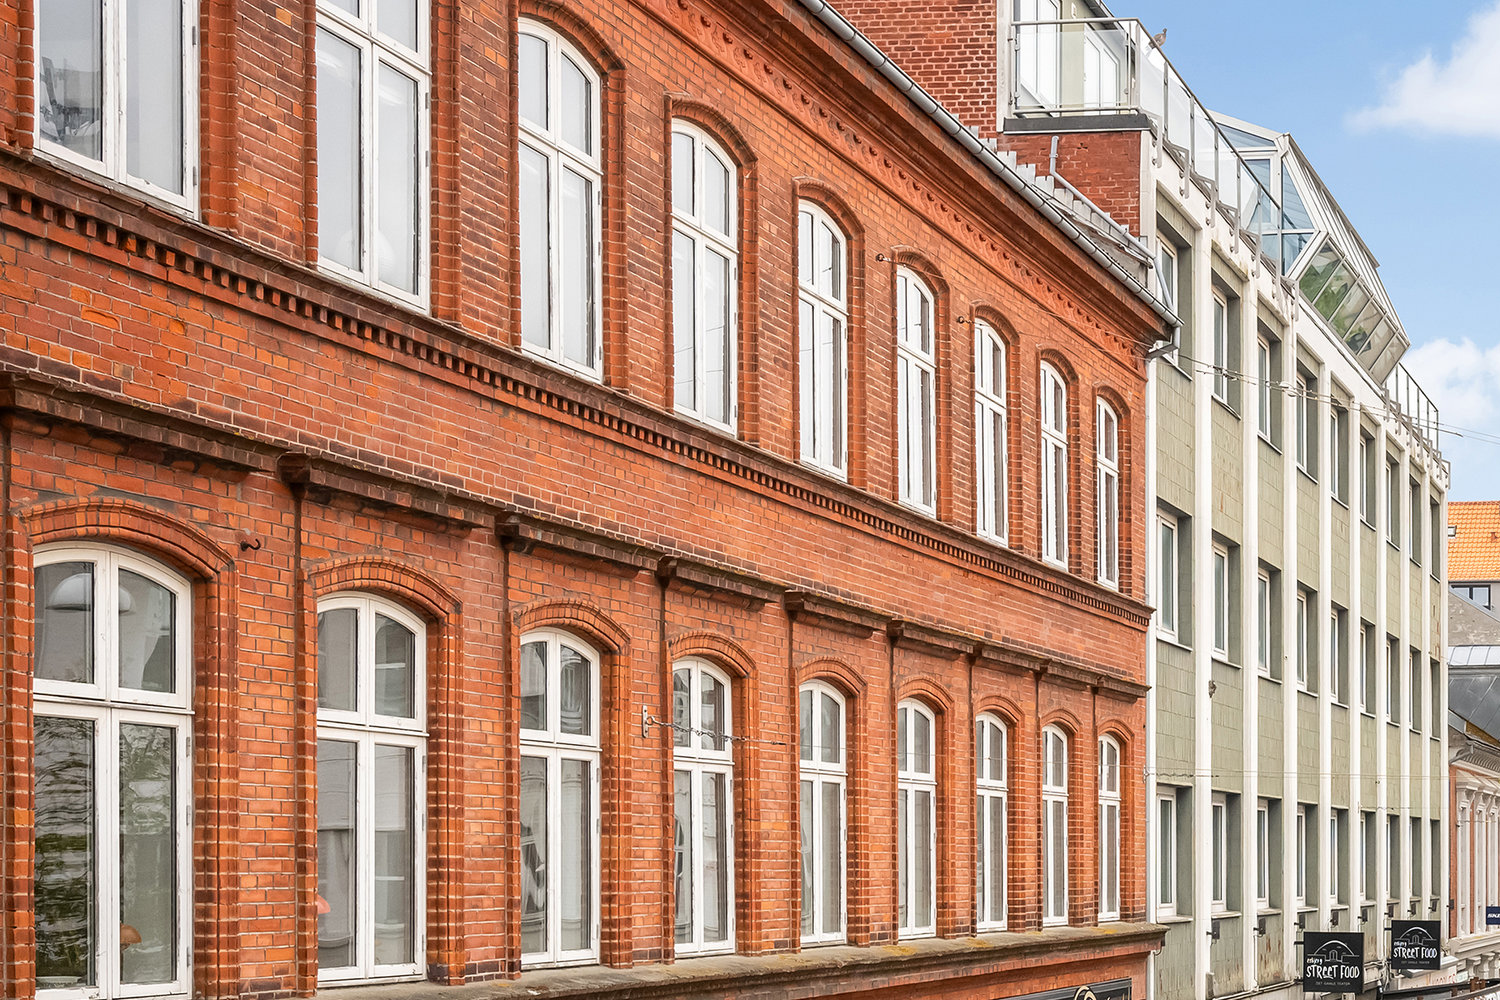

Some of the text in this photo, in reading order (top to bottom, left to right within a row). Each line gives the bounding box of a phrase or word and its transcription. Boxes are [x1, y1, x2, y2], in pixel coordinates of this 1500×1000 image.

[1393, 947, 1438, 960] STREET FOOD
[1306, 965, 1360, 980] STREET FOOD
